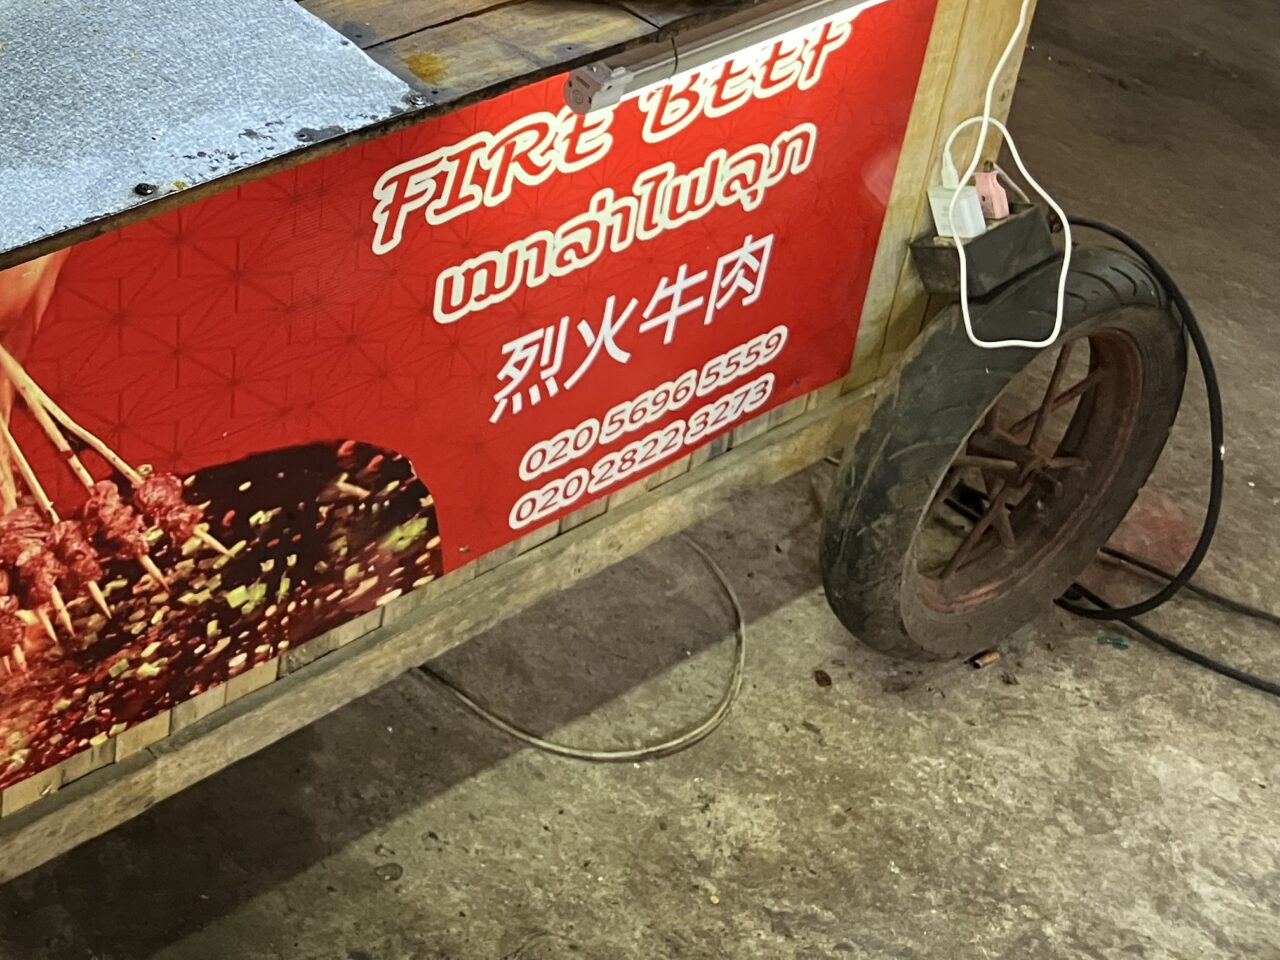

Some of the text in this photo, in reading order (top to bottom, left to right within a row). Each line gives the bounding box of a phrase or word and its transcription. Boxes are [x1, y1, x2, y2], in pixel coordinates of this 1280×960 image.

[372, 16, 851, 255] FIRE BEEF
[488, 233, 775, 423] 烈火牛肉
[519, 324, 788, 481] 020 5696 5559
[508, 372, 776, 529] 020 2822 3273
